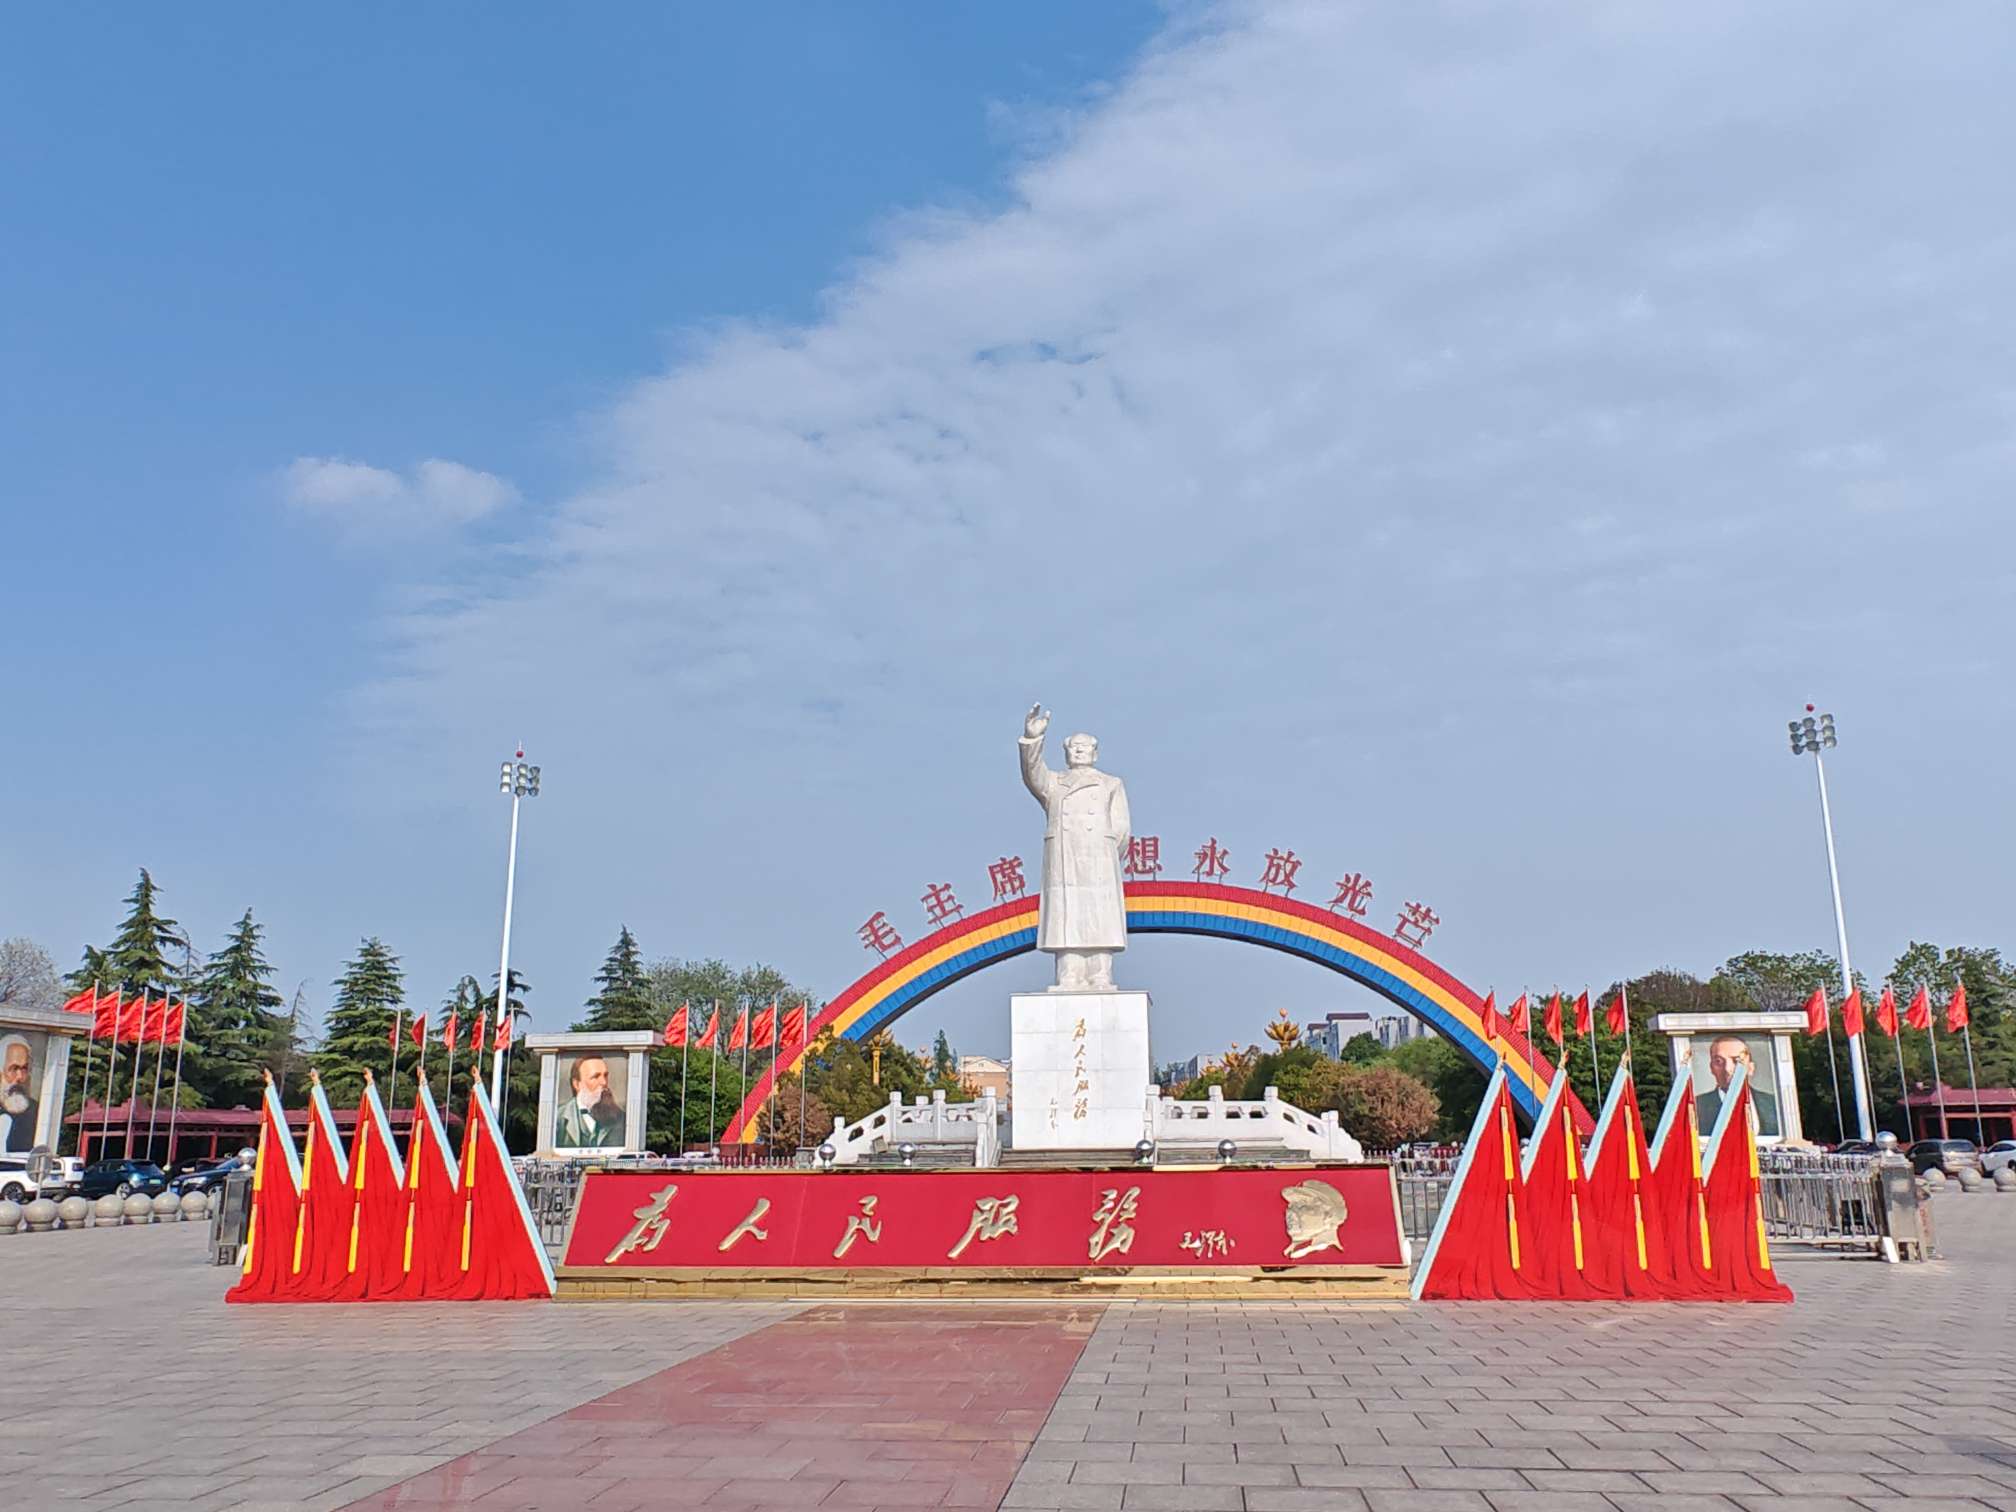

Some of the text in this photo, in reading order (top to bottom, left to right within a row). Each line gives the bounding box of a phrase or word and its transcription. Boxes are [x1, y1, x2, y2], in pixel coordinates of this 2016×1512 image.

[856, 836, 1440, 951] 毛主席想永放光芒
